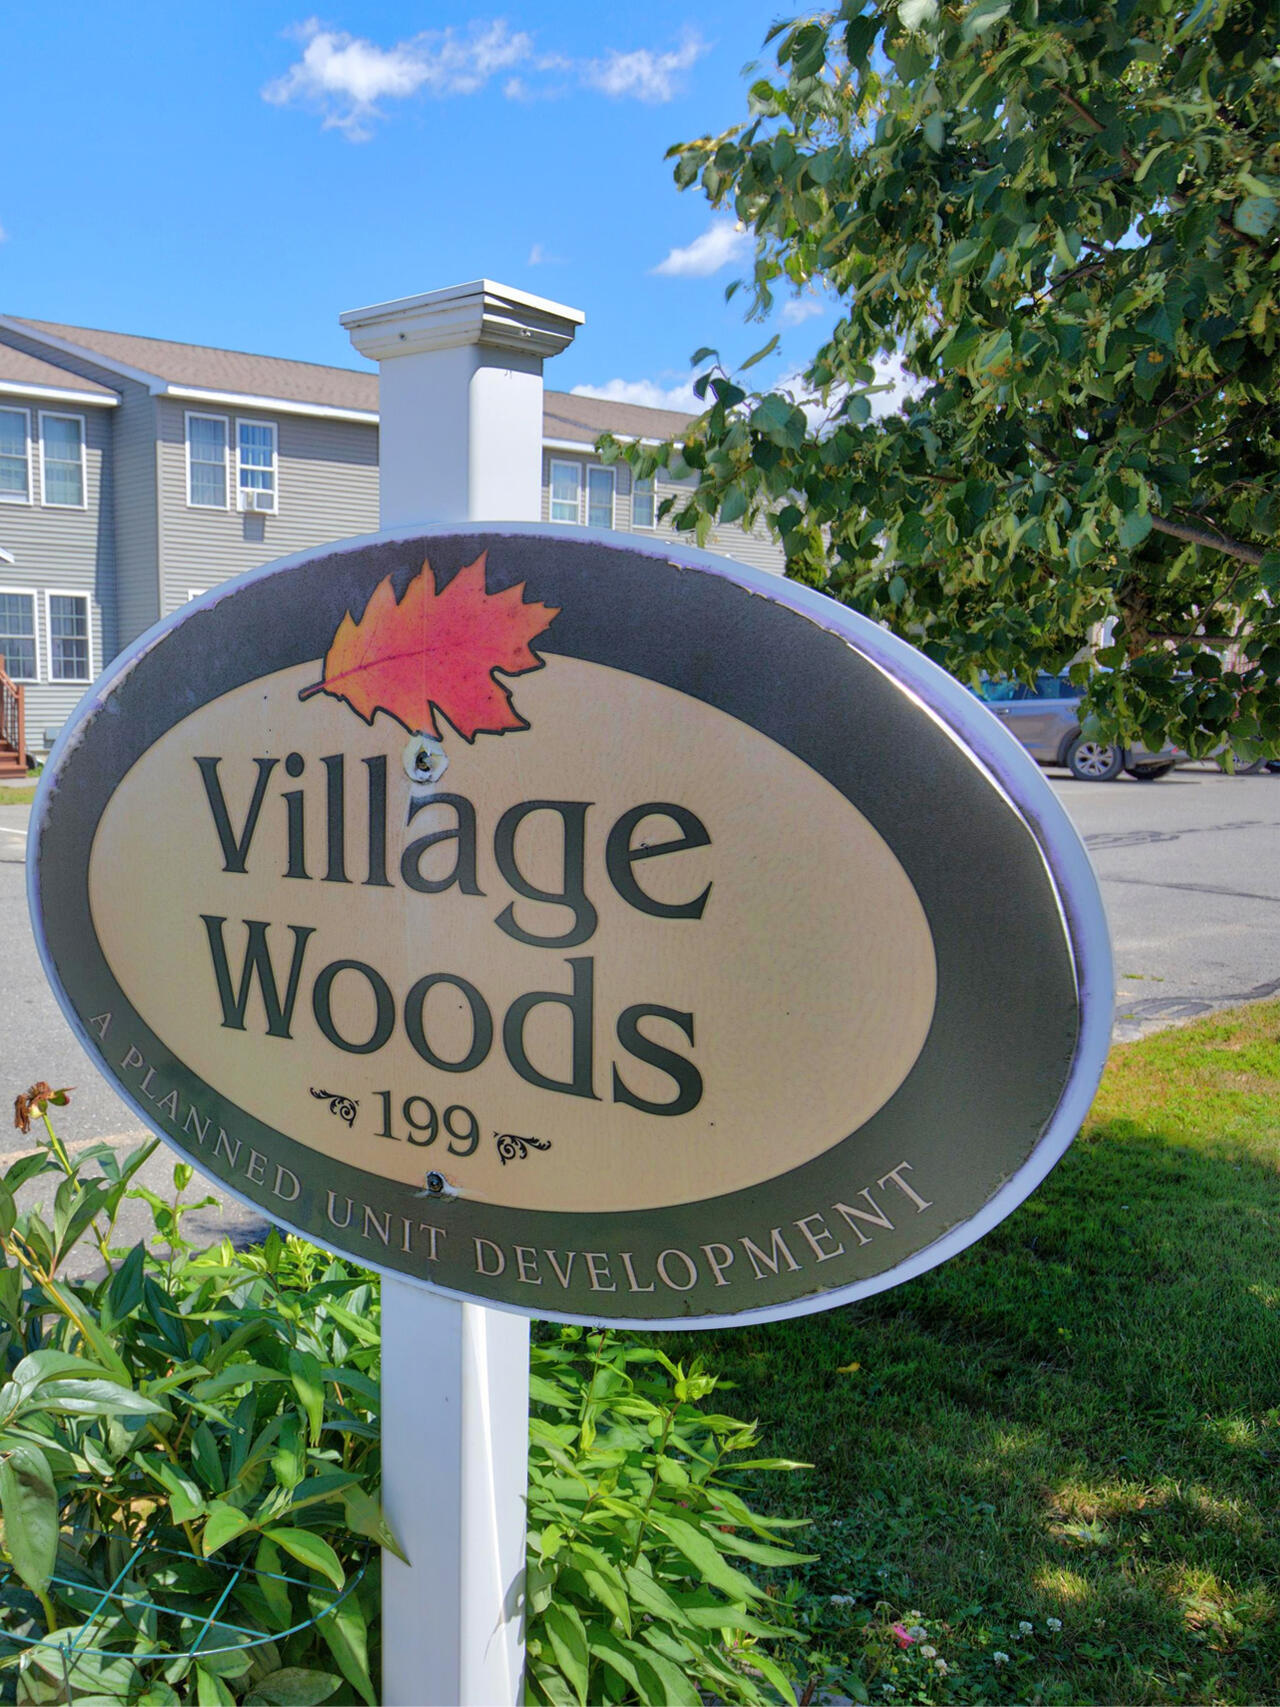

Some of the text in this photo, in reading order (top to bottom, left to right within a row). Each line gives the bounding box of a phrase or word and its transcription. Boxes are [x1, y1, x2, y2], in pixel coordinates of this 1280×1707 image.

[193, 751, 713, 949] Village
[199, 914, 704, 1117] Woods
[88, 1012, 934, 1294] A PLANNED UNIT DEVELOPMENT
[372, 1090, 480, 1157] 199
